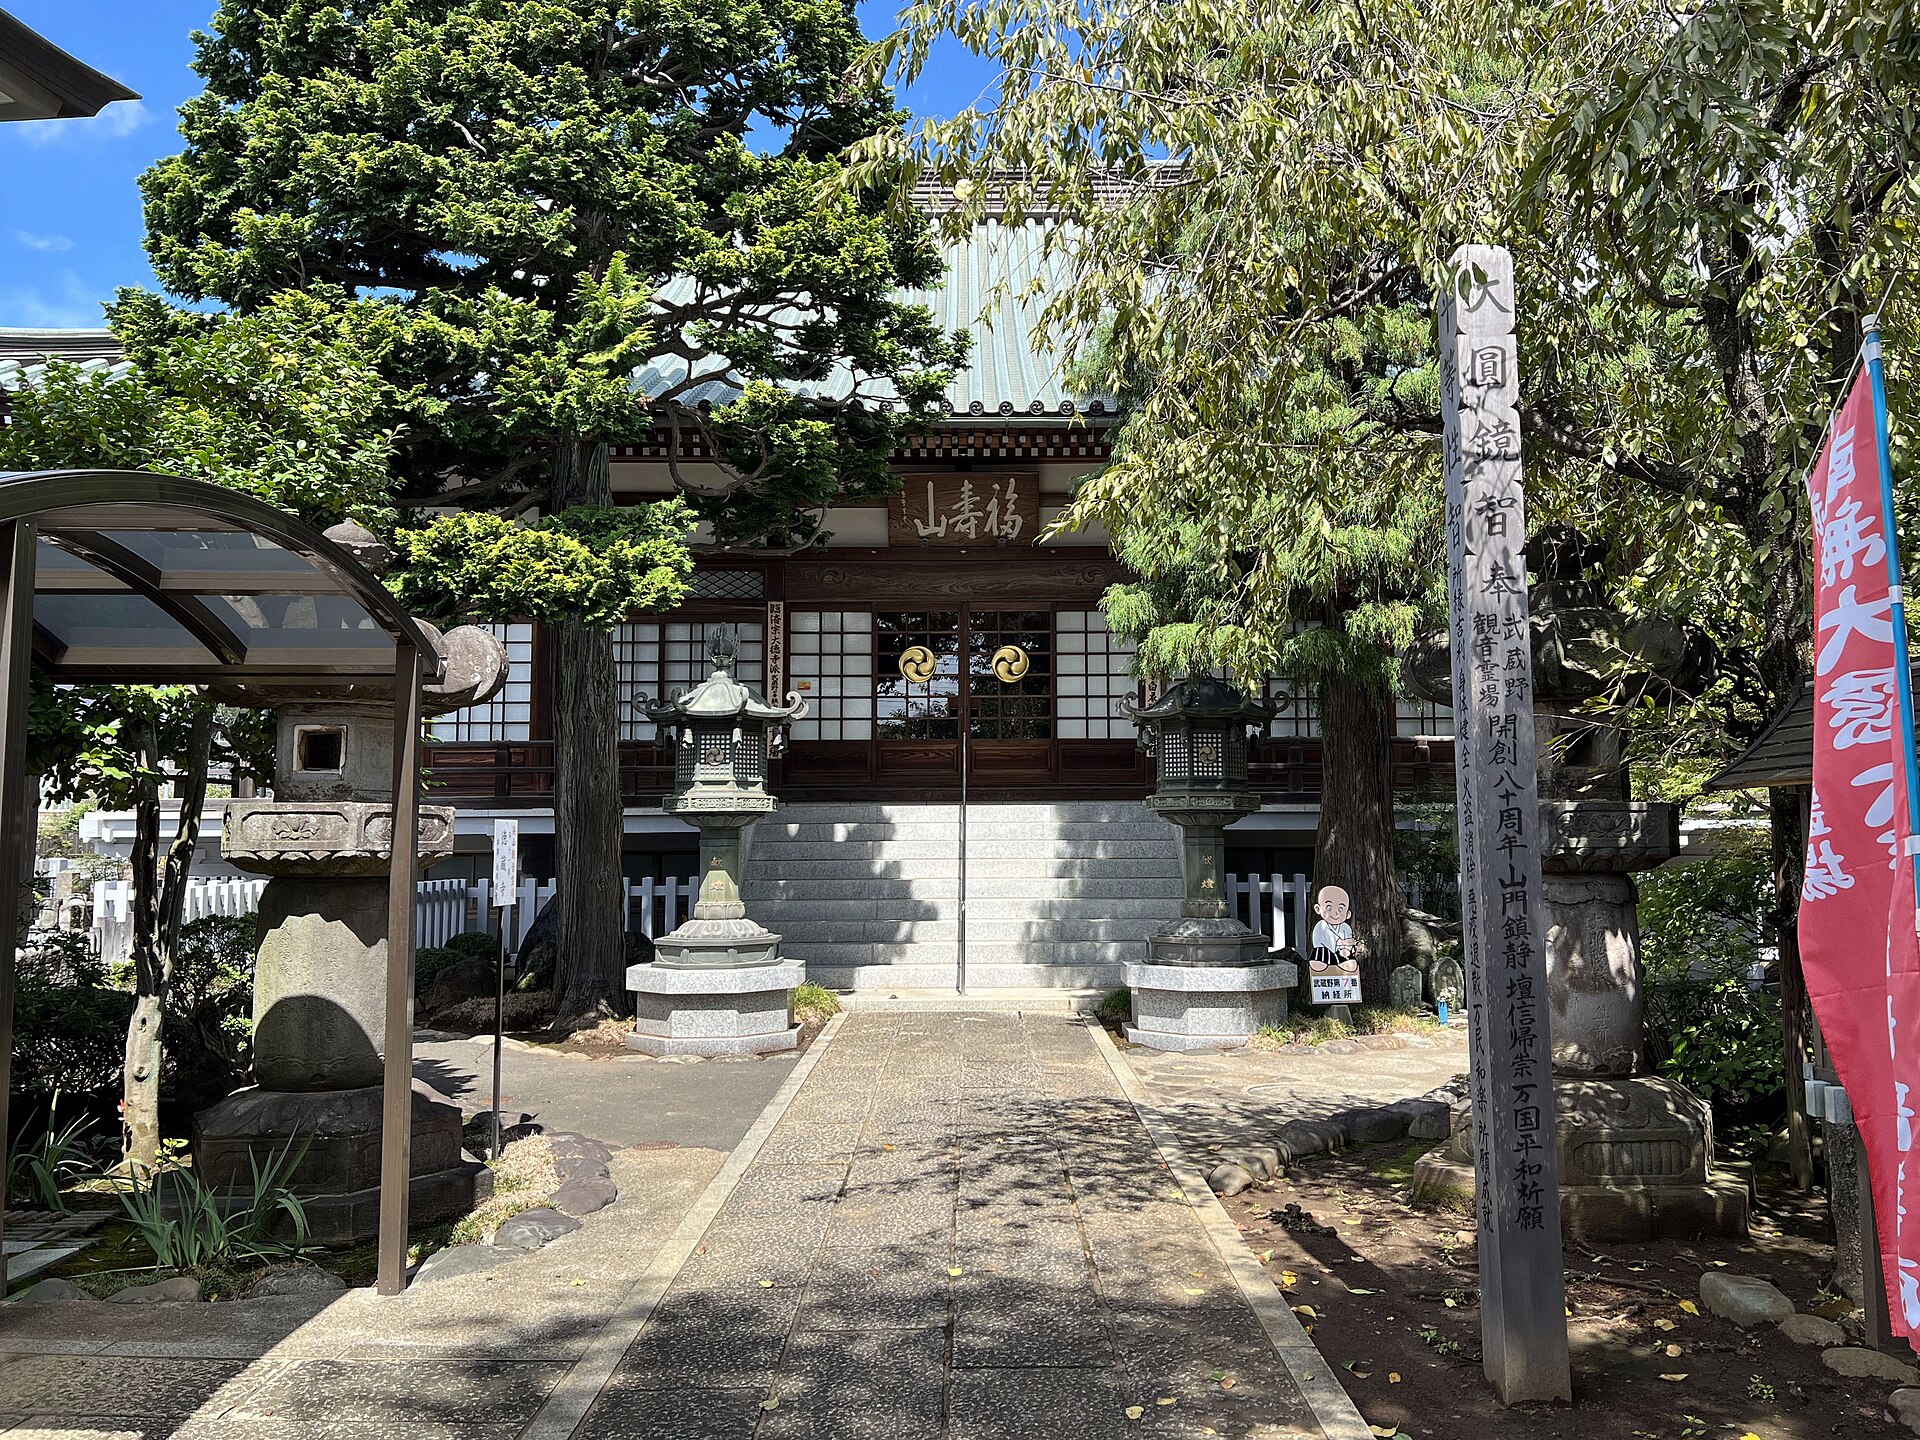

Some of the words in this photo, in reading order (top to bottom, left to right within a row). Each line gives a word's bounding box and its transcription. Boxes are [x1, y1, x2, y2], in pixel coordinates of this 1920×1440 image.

[1473, 611, 1501, 707] 観音霊場
[1503, 614, 1529, 701] 武蔵野
[1321, 989, 1352, 999] 納経所
